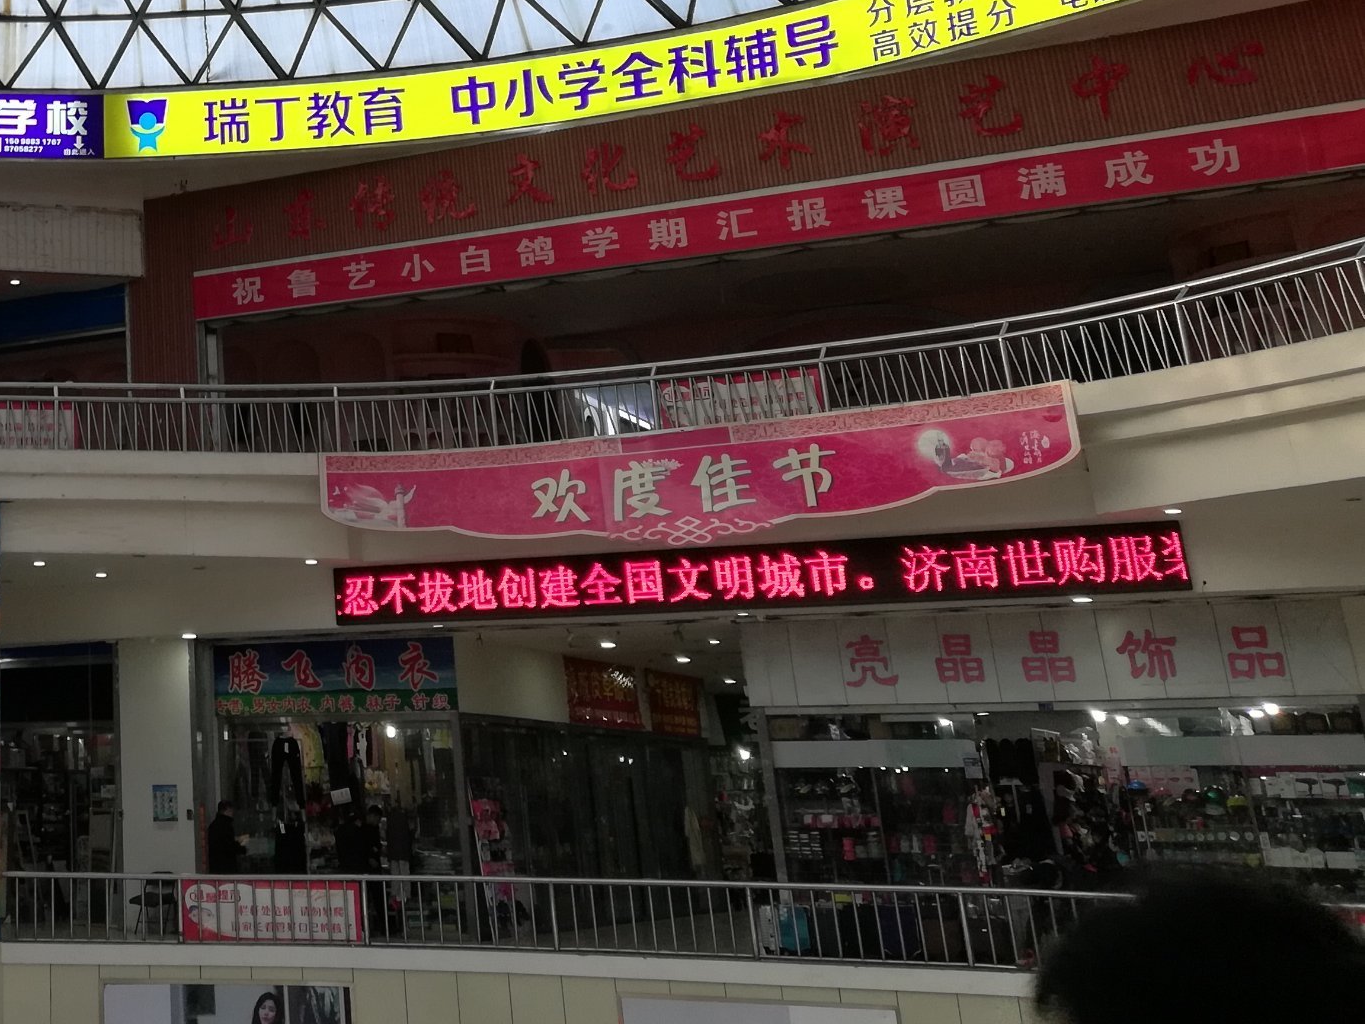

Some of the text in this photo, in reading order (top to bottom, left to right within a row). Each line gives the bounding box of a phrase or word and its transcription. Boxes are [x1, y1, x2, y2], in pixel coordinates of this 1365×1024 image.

[870, 0, 1016, 61] 高效提分
[203, 15, 839, 146] 瑞丁教育 中小学全科辅导
[232, 138, 1242, 306] 祝鲁艺小白鸽学期汇报课圆满成功
[530, 444, 838, 524] 欢度佳节
[337, 551, 874, 617] 忍不拔地创建全国文明城市。
[228, 641, 440, 695] 腾飞内衣
[845, 626, 1286, 688] 亮晶晶饰品
